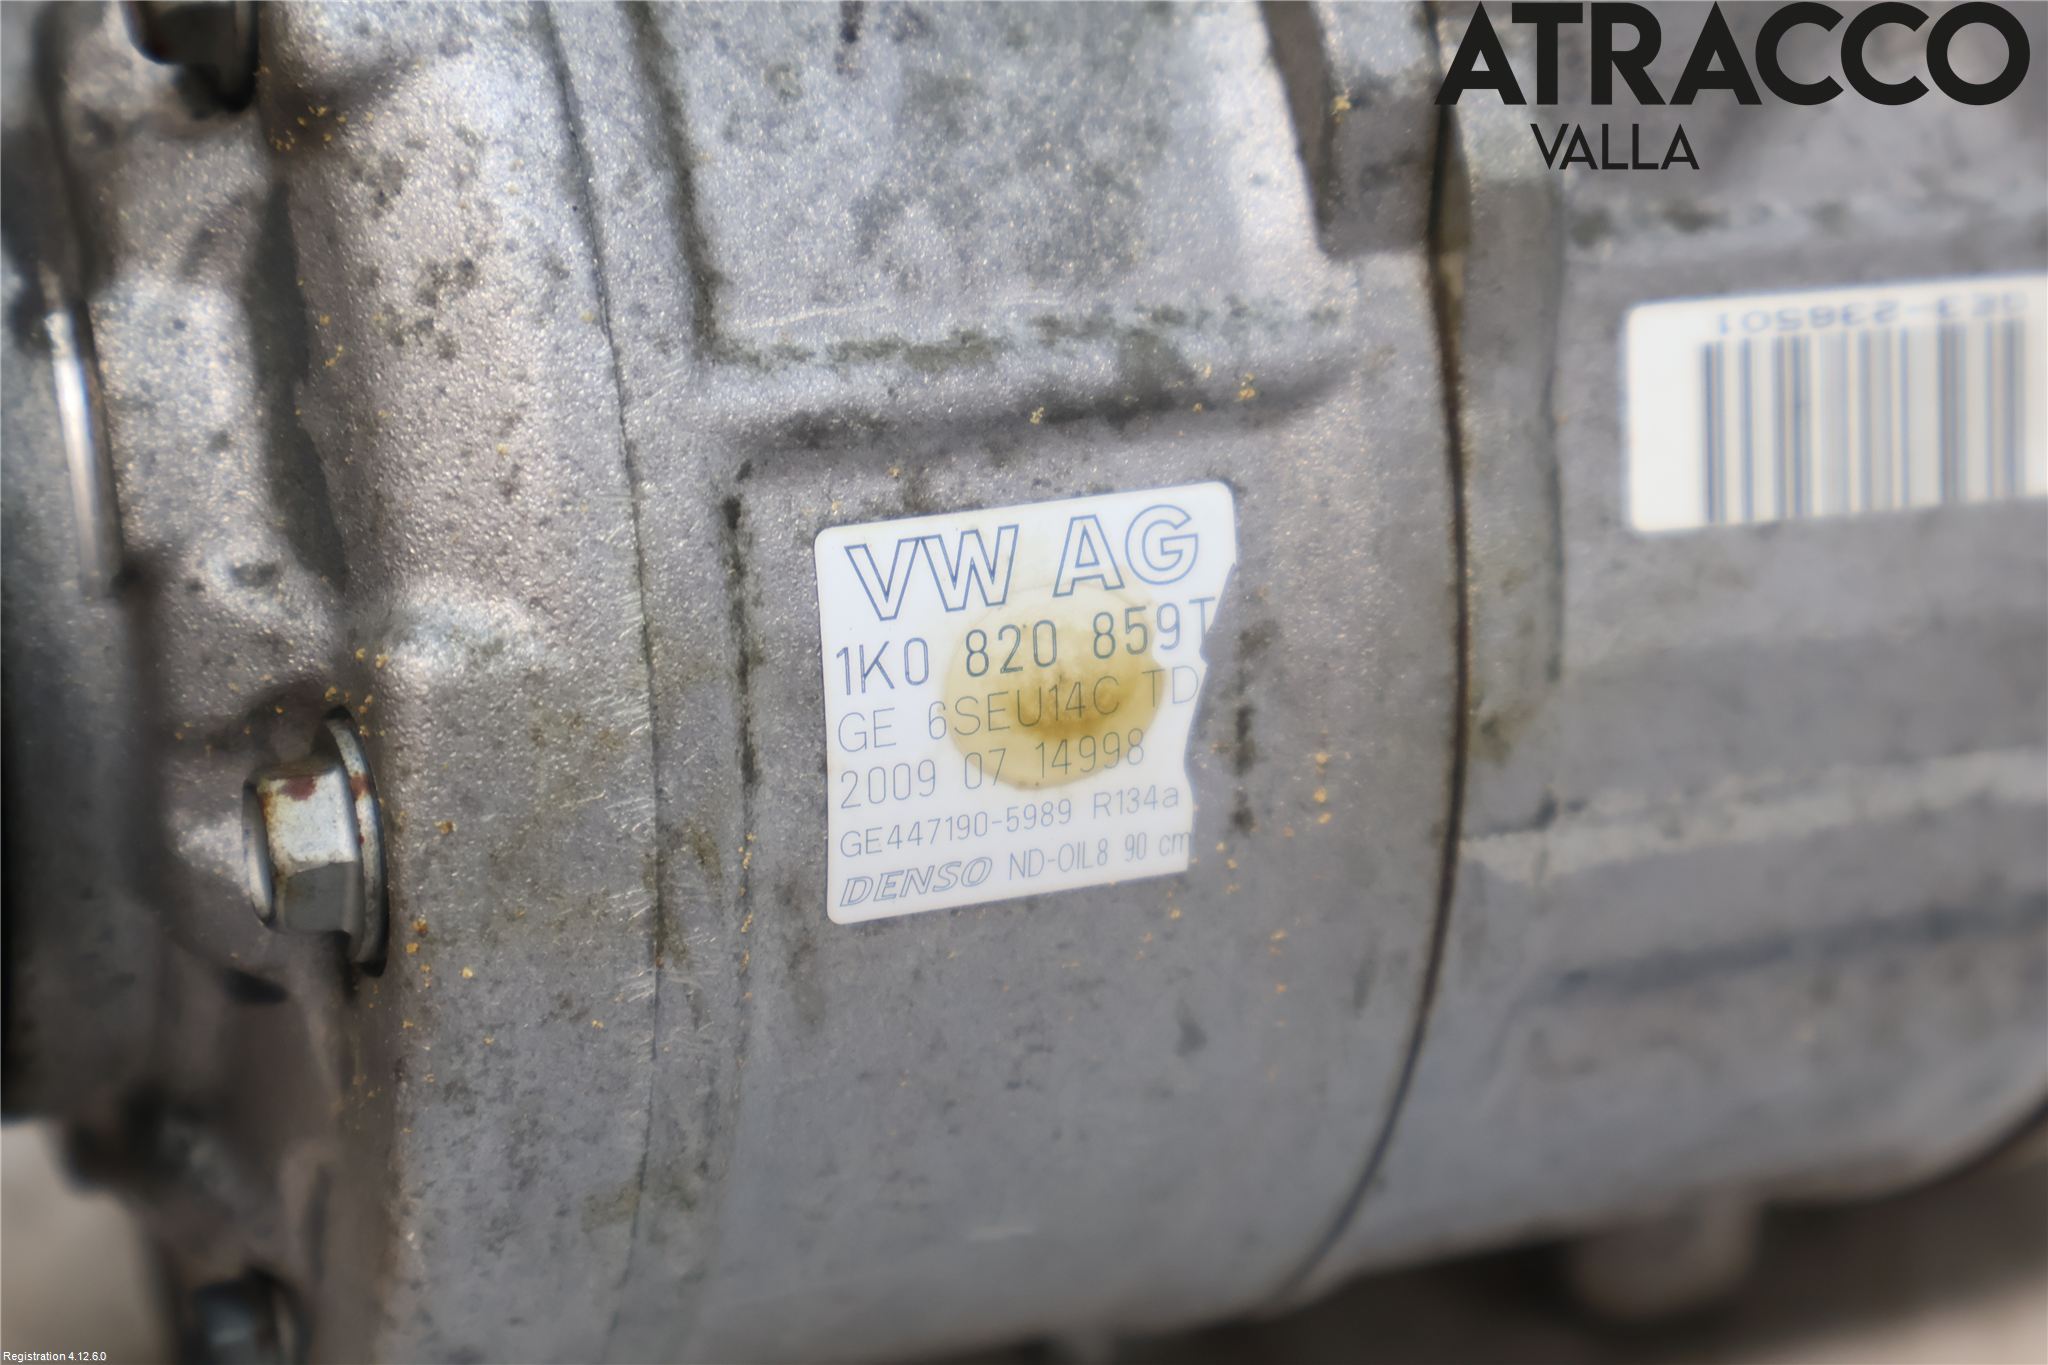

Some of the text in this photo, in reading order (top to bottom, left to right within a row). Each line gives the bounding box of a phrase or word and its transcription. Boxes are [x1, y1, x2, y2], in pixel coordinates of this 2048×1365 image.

[844, 504, 1199, 621] VW AG
[836, 596, 1216, 696] 1K0 820 859T
[838, 665, 1199, 753] GE 6SEU14C TD
[840, 727, 1145, 809] 2009 07 14998
[840, 784, 1179, 858] GE447190-5989 R134a
[839, 856, 993, 908] DENSO
[1008, 837, 1109, 881] ND-OIL8
[1124, 831, 1147, 862] 90
